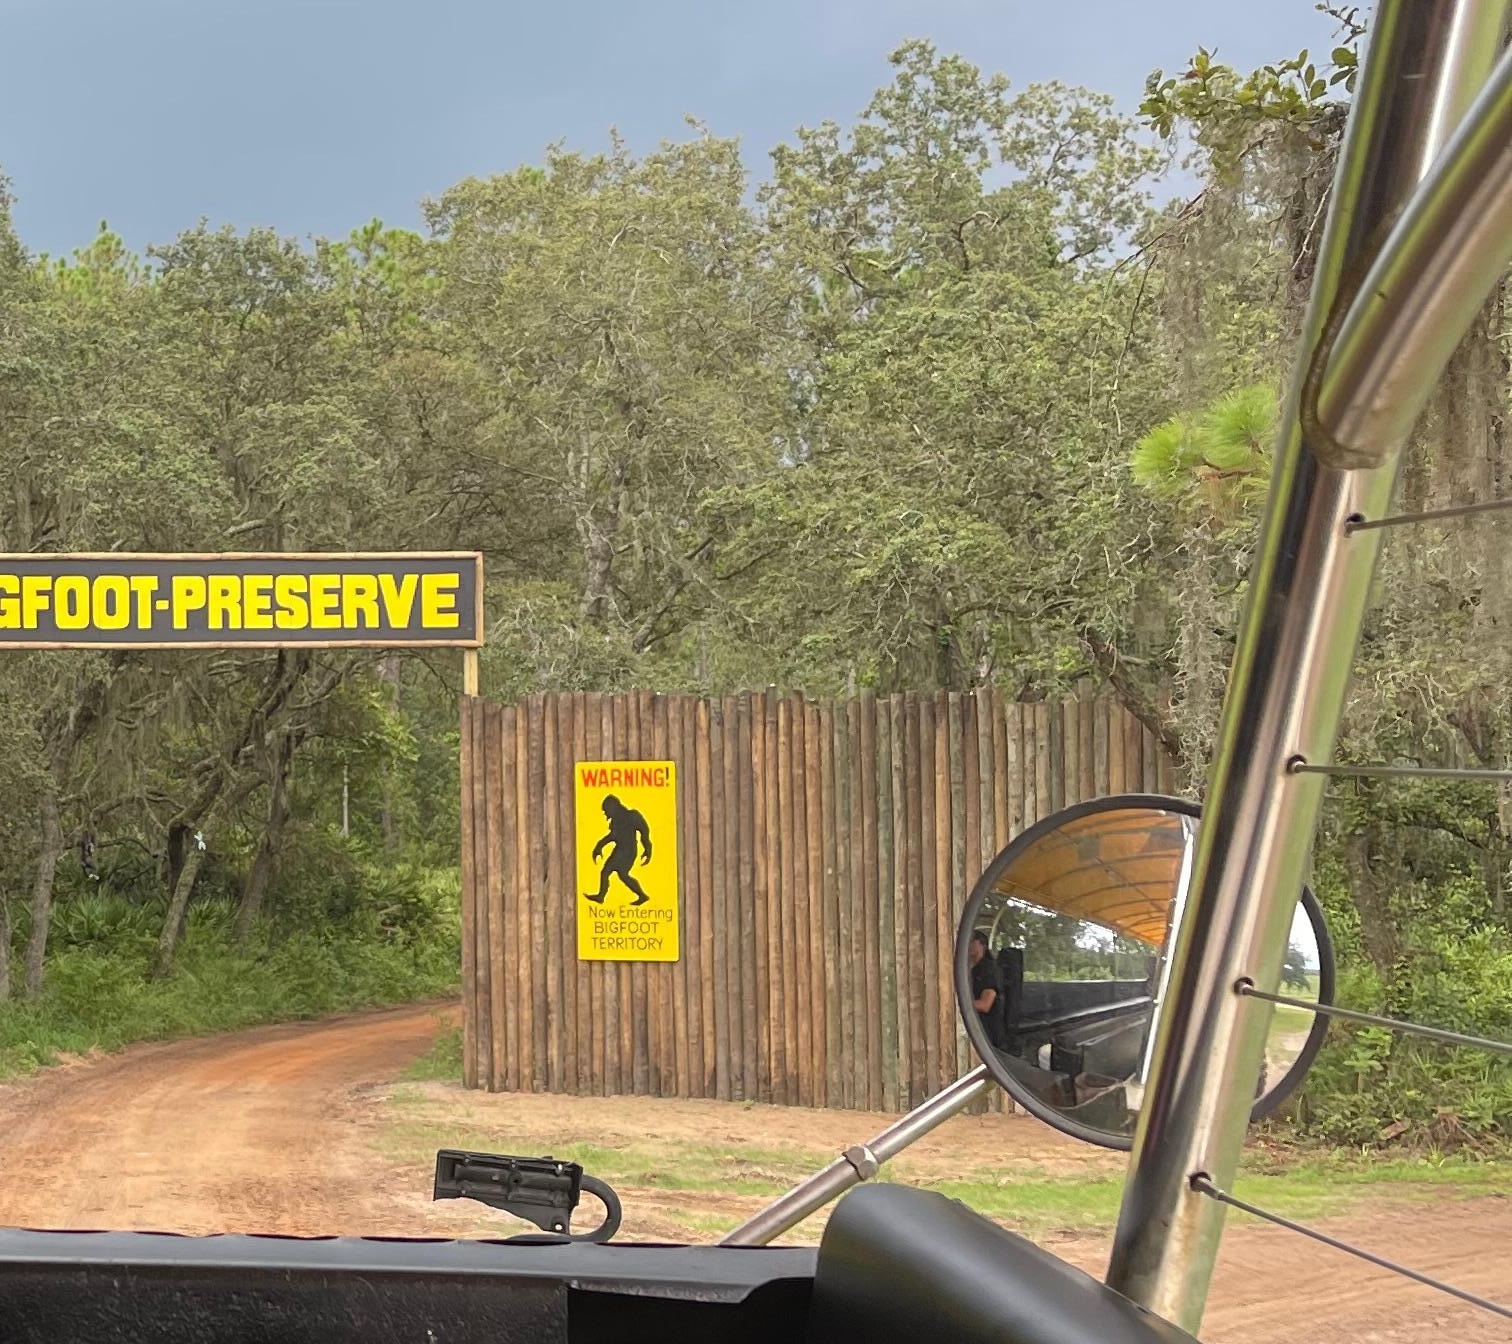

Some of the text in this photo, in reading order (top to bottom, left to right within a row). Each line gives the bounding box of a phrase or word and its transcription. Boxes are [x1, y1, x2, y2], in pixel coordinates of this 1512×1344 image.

[581, 766, 670, 787] WARNING!
[589, 905, 673, 922] Now Entering
[594, 921, 659, 934] BIGFOOT
[592, 937, 663, 950] TERRITORY
